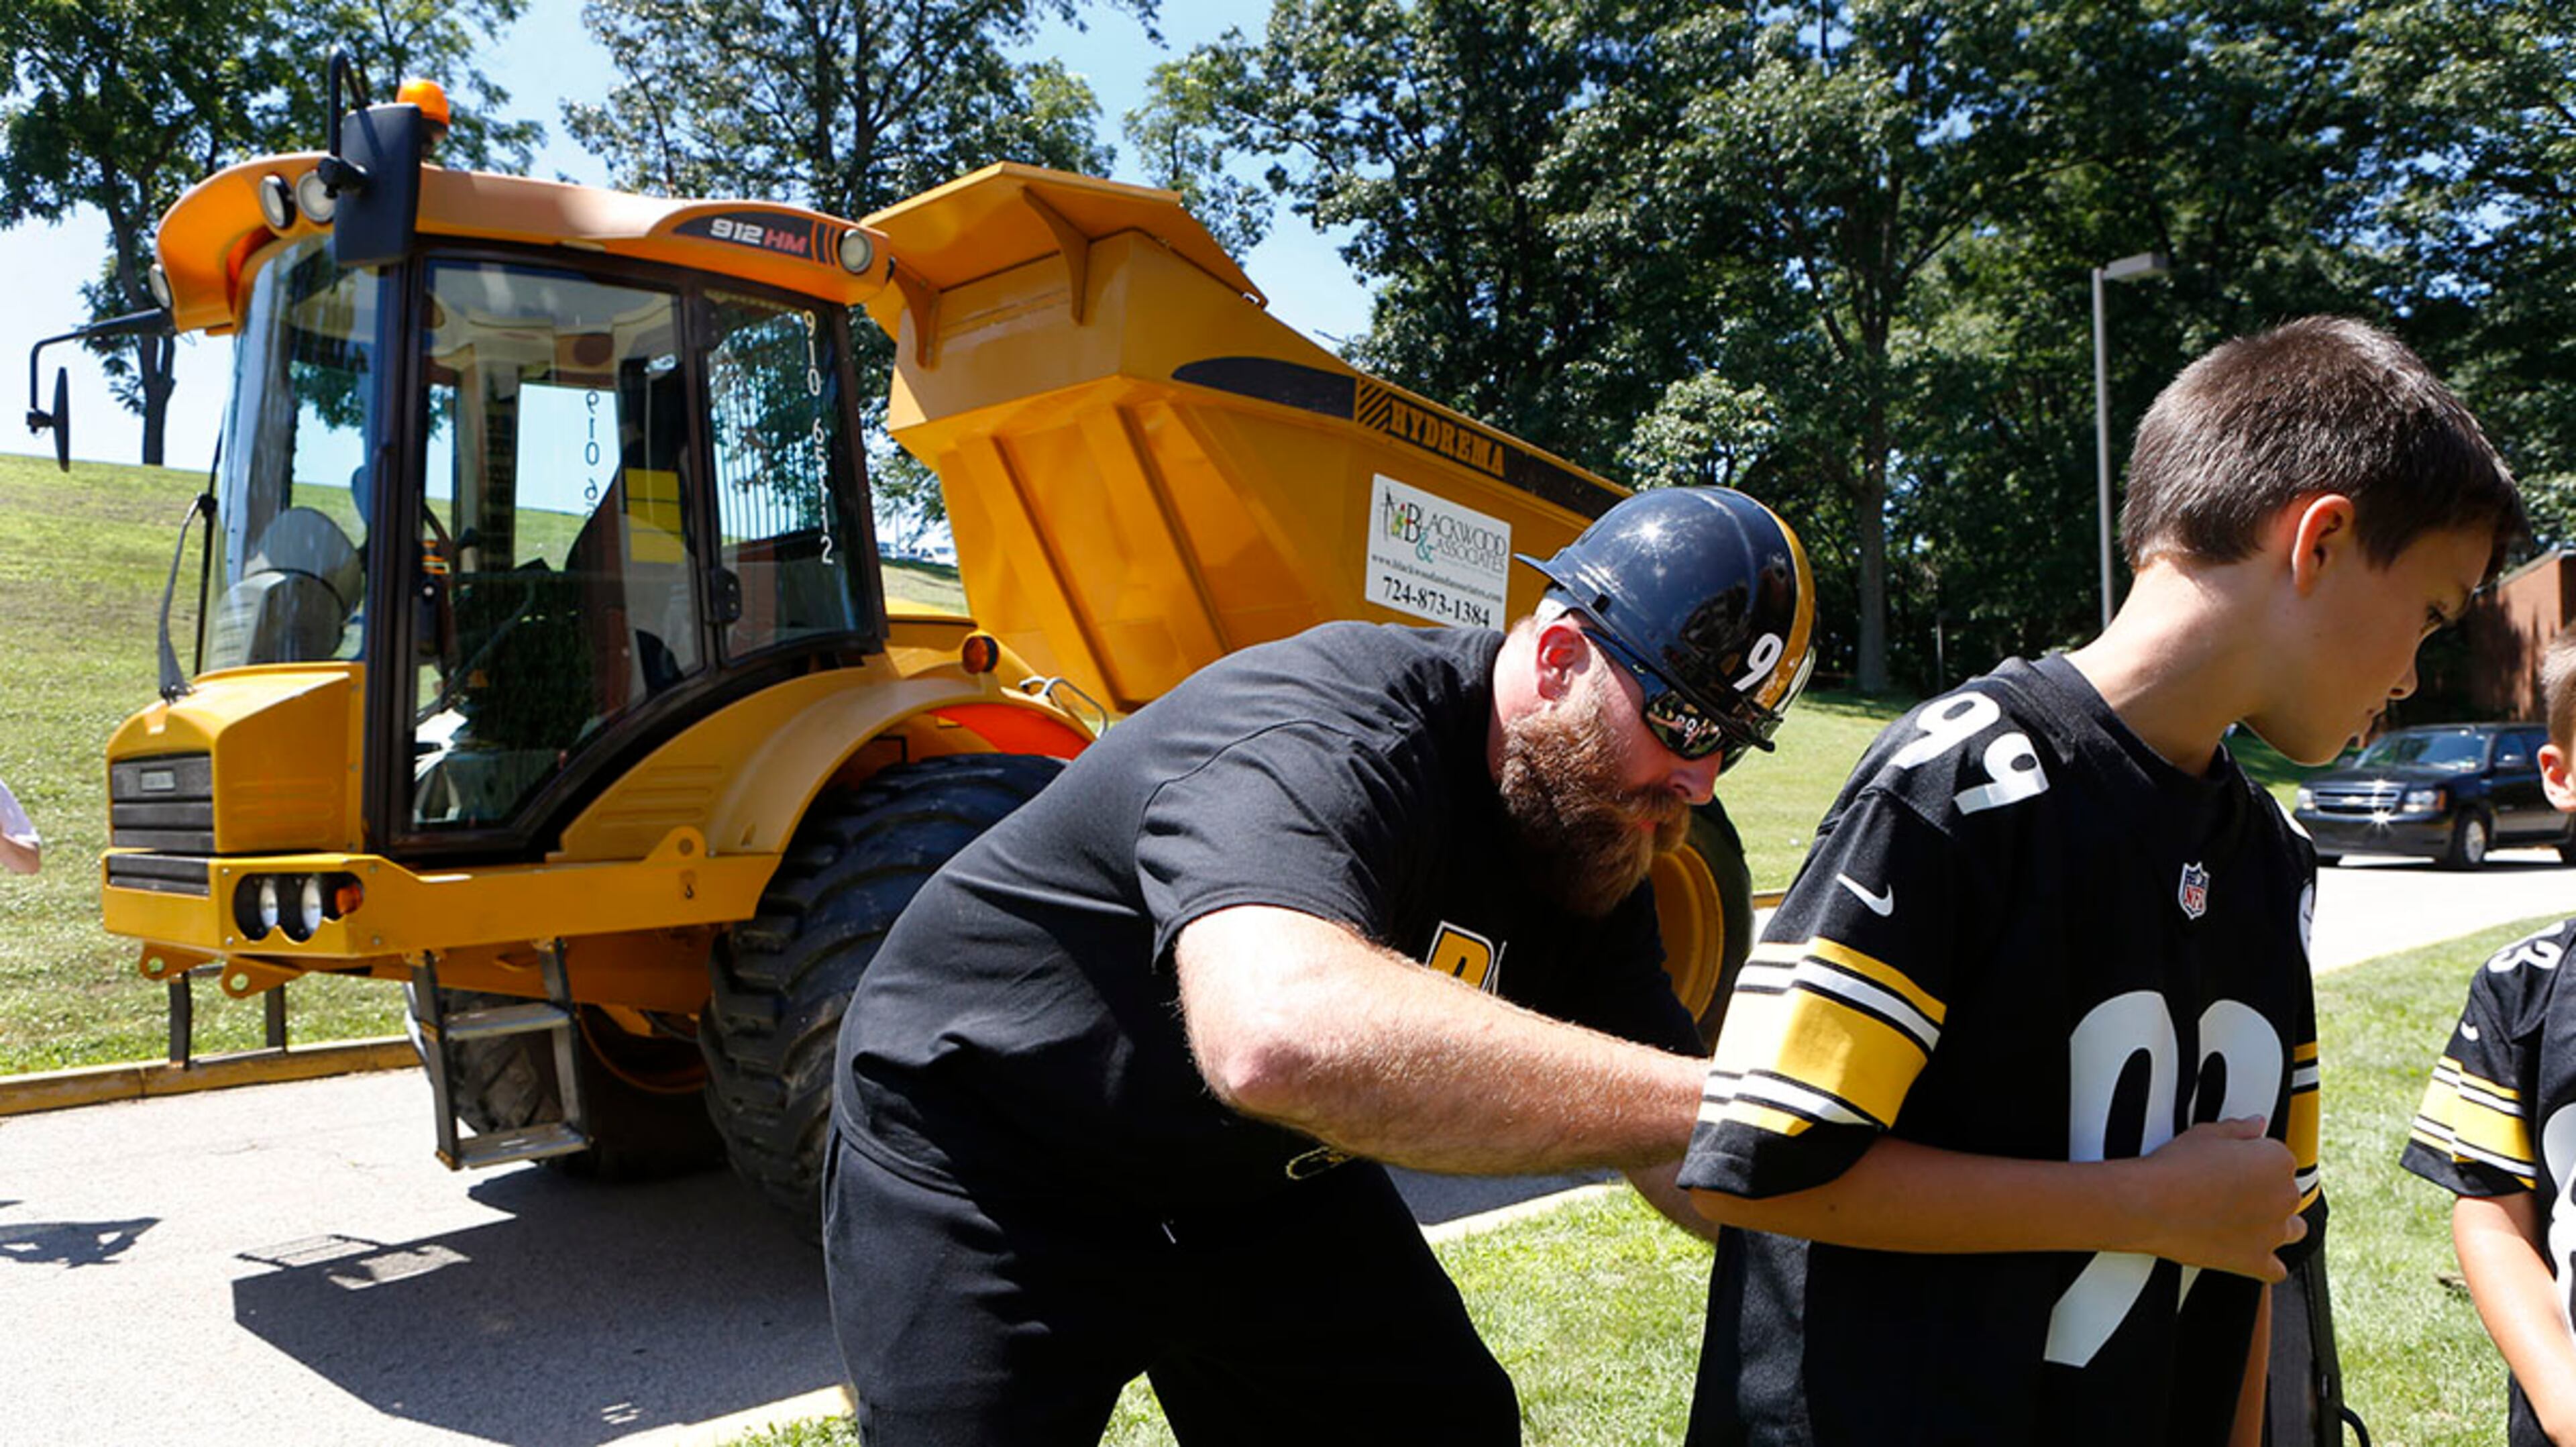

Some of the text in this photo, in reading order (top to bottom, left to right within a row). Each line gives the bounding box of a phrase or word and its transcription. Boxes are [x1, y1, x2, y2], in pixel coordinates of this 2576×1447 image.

[804, 309, 822, 396] 910
[1391, 398, 1505, 477] HYDREMA
[1405, 502, 1507, 557] BLACKWOOD
[1415, 531, 1434, 564] &
[1436, 539, 1505, 572] ASSOCIATES
[1383, 575, 1490, 629] 724-873-1384
[1733, 633, 1784, 692] 9
[1887, 691, 2051, 816] 99
